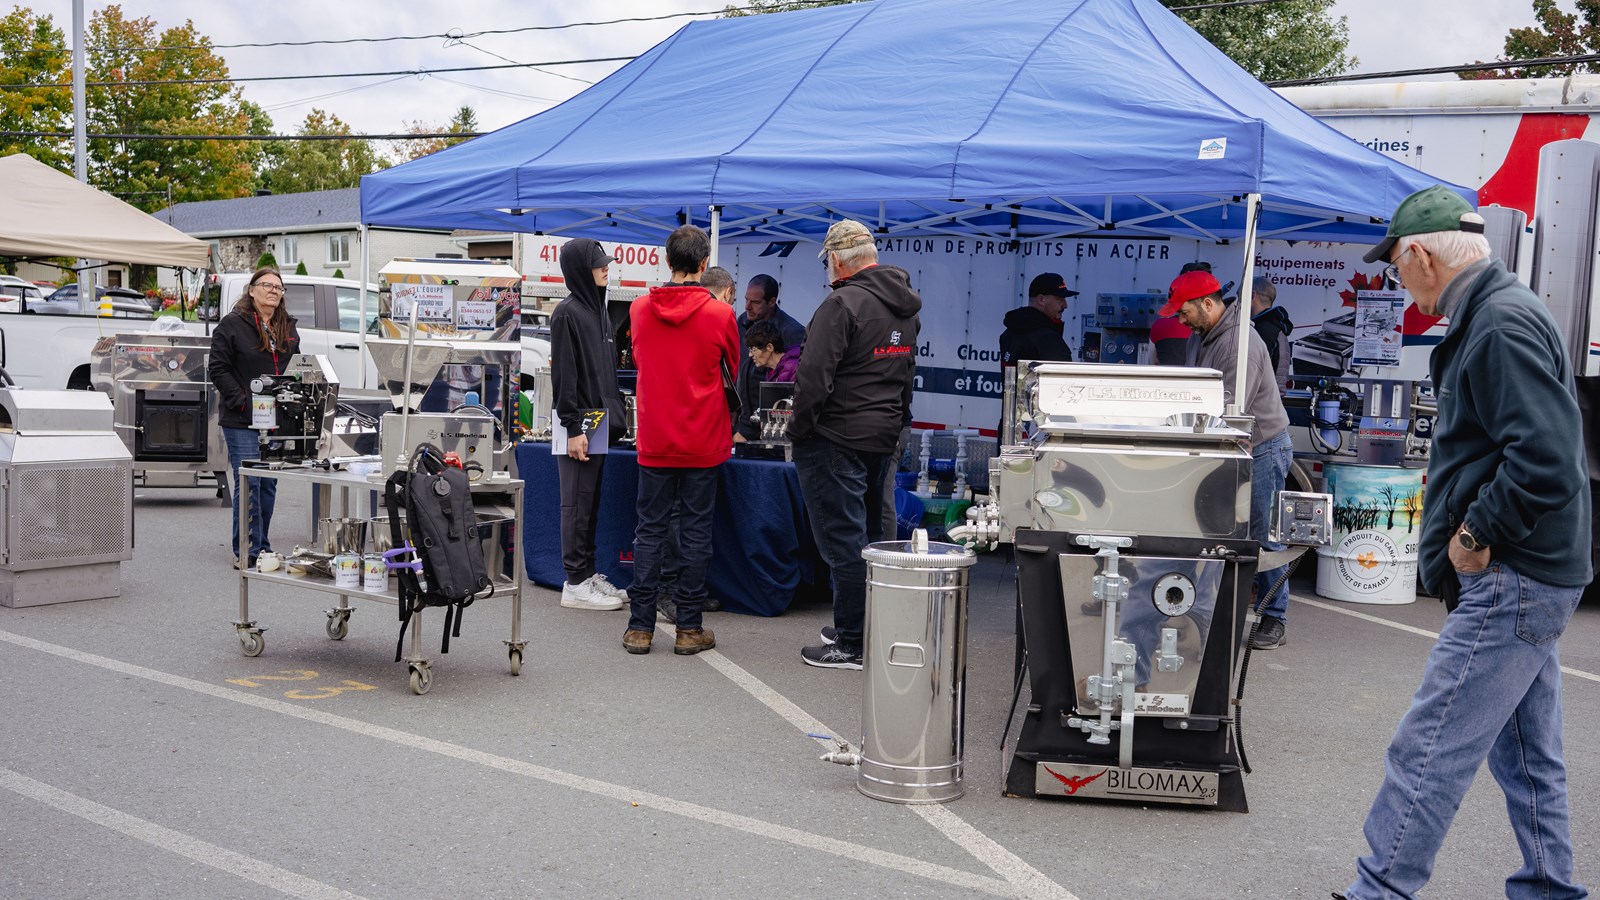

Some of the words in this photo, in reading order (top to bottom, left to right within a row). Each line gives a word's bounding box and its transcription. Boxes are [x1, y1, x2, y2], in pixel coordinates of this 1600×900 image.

[540, 245, 563, 262] 41
[614, 246, 659, 266] 0006
[875, 239, 934, 253] CATION
[945, 240, 965, 254] DE
[1076, 243, 1098, 258] EN
[1110, 244, 1170, 259] ACIER
[1255, 252, 1345, 271] Équipements
[416, 286, 444, 294] L'ÉQUIPE
[957, 344, 1002, 362] Chau
[955, 376, 972, 391] et
[976, 375, 1003, 394] fou
[1088, 387, 1117, 400] L.S.
[1119, 387, 1191, 401] Bilodeau
[1344, 533, 1373, 547] PRODUIT
[1374, 535, 1385, 544] DU
[1337, 556, 1353, 583] PRODUCT
[1353, 580, 1362, 588] OF
[1363, 576, 1390, 590] CANADA
[1107, 769, 1205, 793] BILOMAX
[1200, 788, 1217, 798] 2.3
